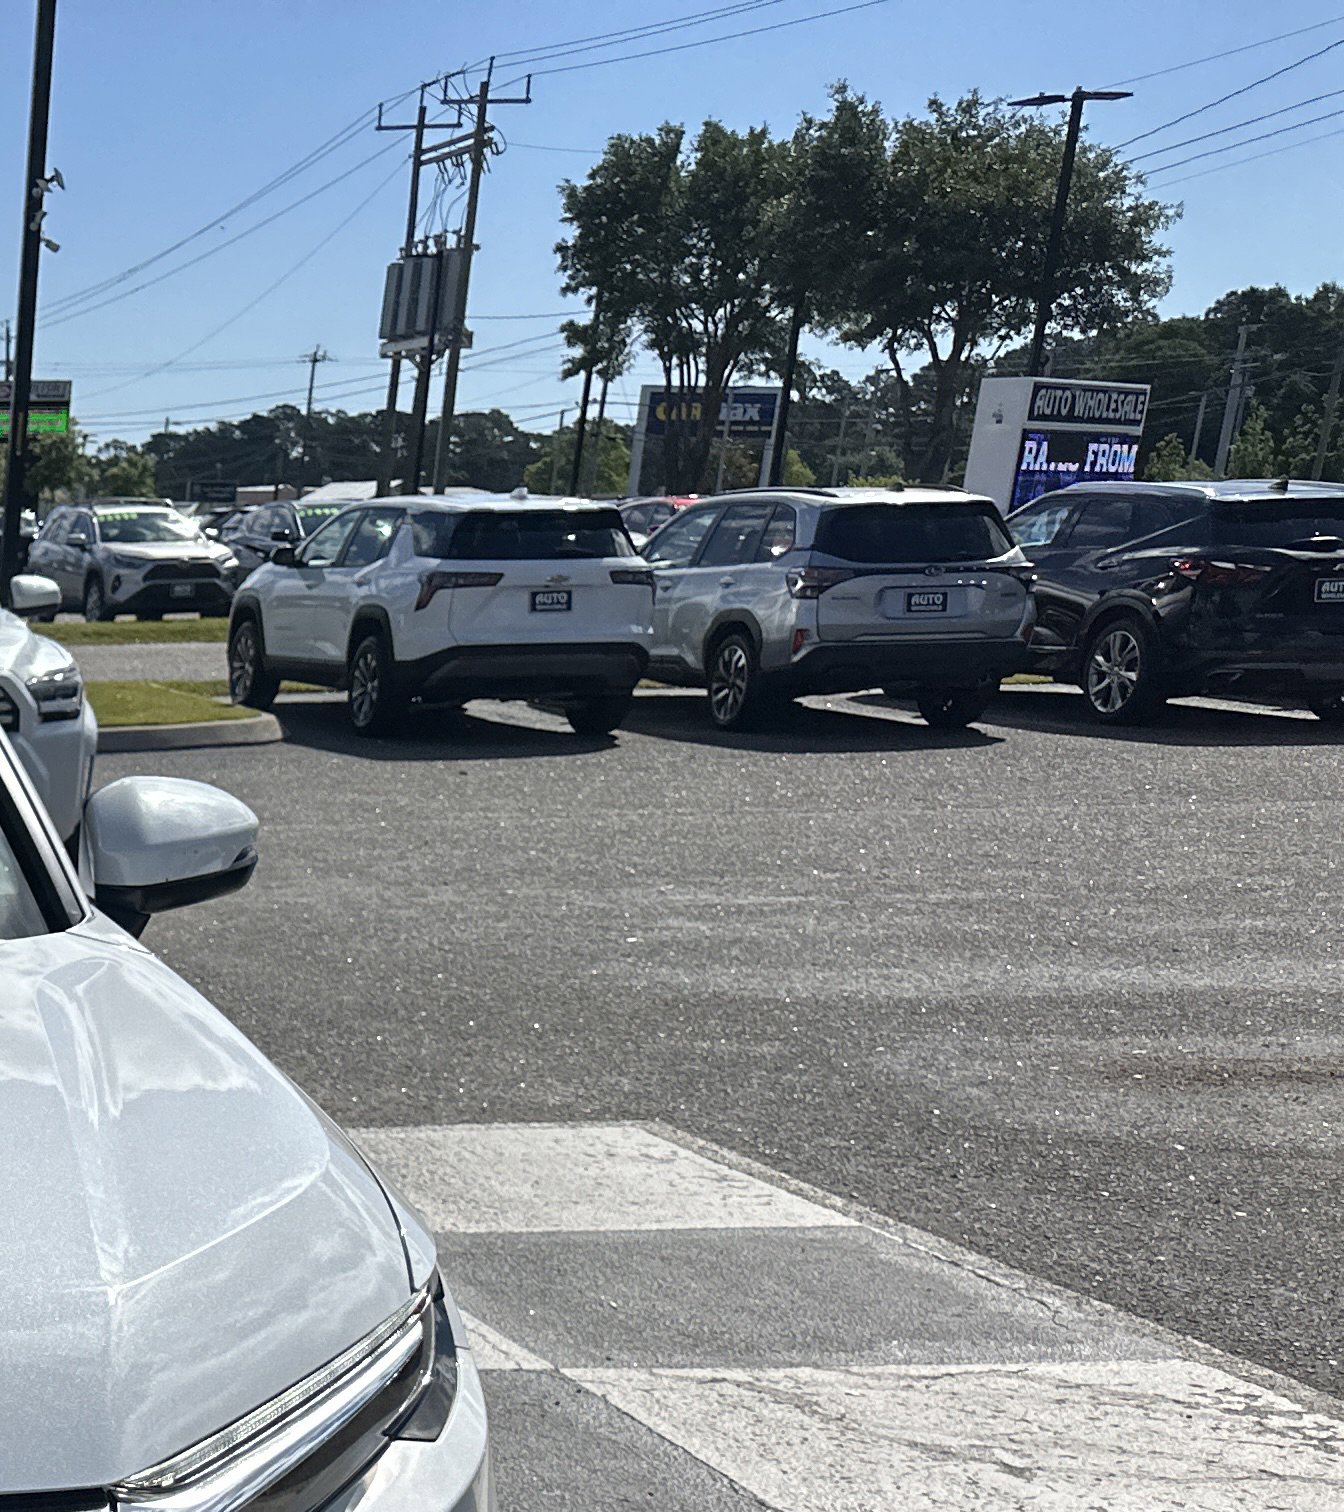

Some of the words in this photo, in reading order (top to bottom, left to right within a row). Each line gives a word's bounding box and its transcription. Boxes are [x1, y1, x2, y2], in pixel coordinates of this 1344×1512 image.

[1034, 387, 1072, 417] AUTO
[1073, 389, 1145, 422] WHOLESALE
[1084, 442, 1139, 473] FROM
[1321, 581, 1344, 593] AUT
[535, 591, 569, 604] AUTO
[911, 593, 943, 606] AUTO
